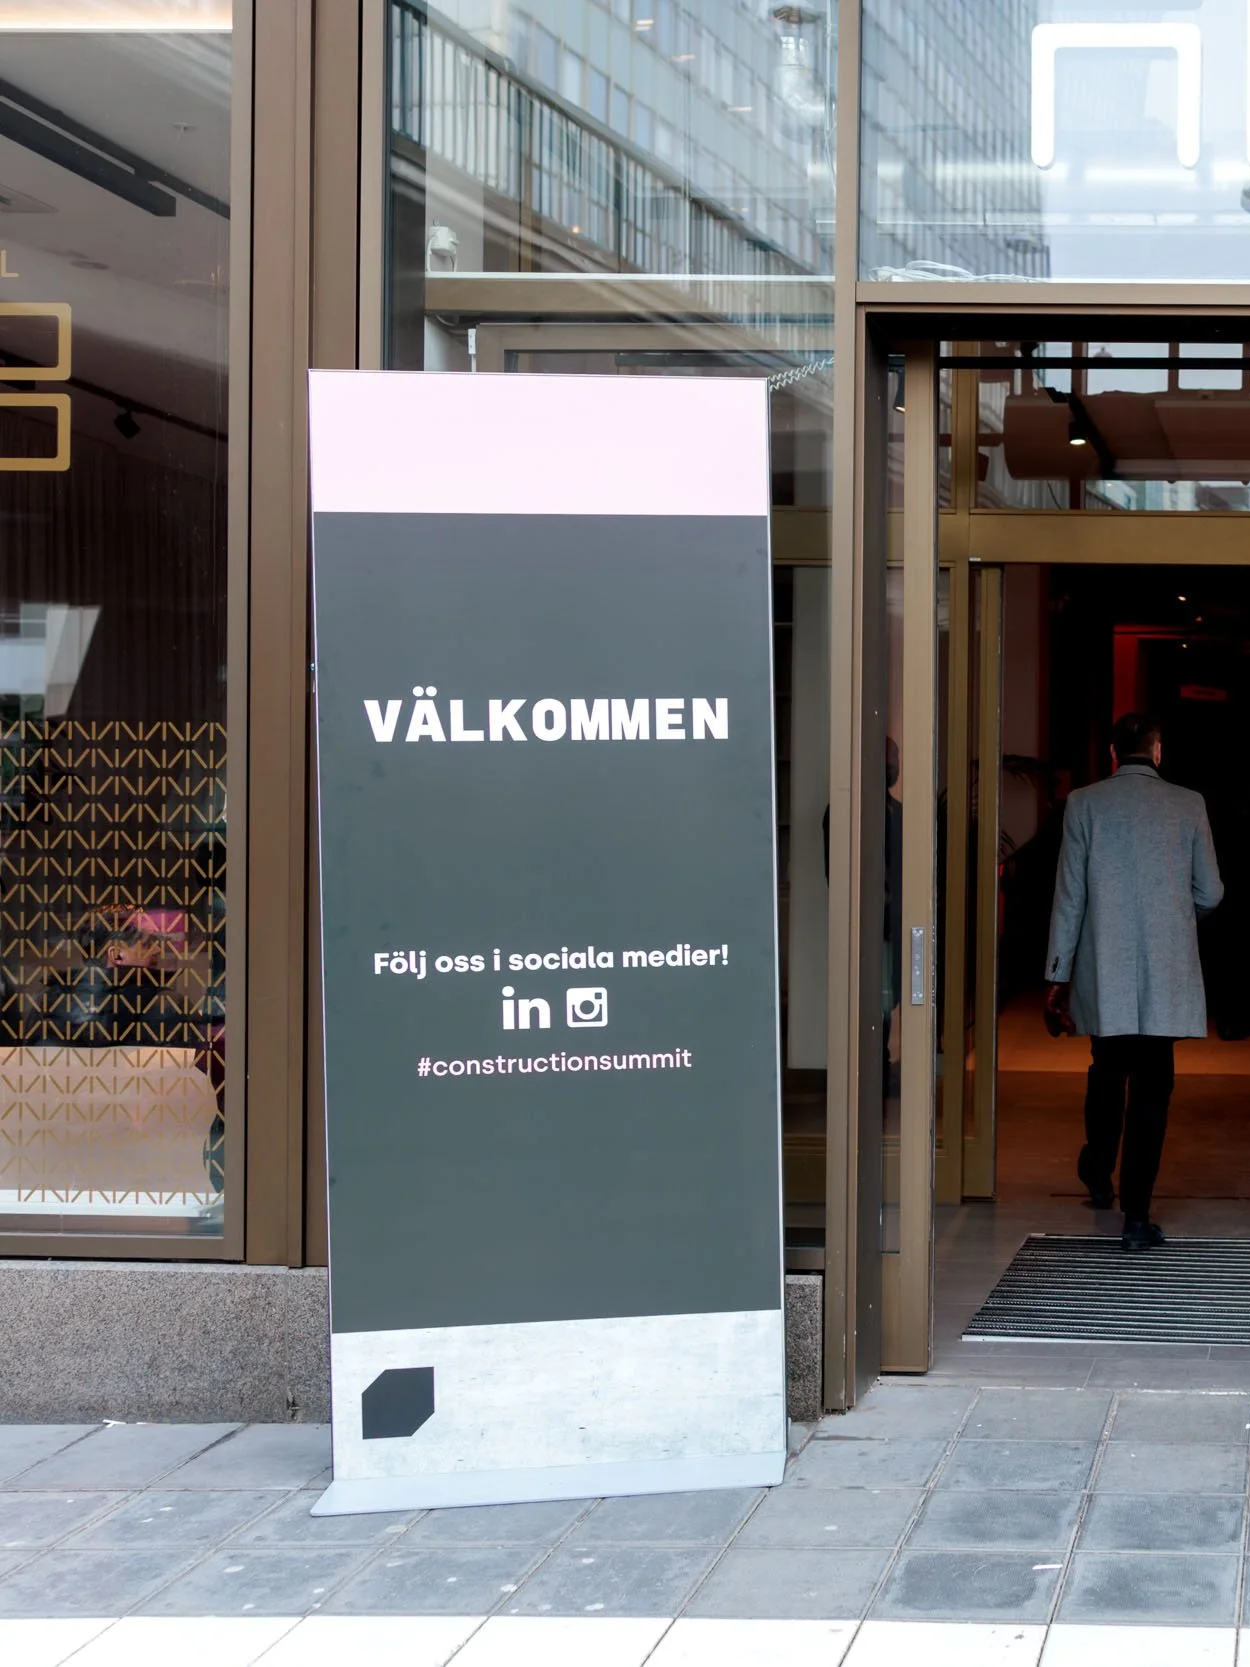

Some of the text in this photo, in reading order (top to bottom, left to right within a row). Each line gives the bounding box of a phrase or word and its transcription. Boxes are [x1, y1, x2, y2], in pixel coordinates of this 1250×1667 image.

[363, 685, 729, 743] VÄLKOMMEN
[374, 943, 729, 980] Följ oss i sociala medier!
[417, 1047, 692, 1077] #constructionsummit
